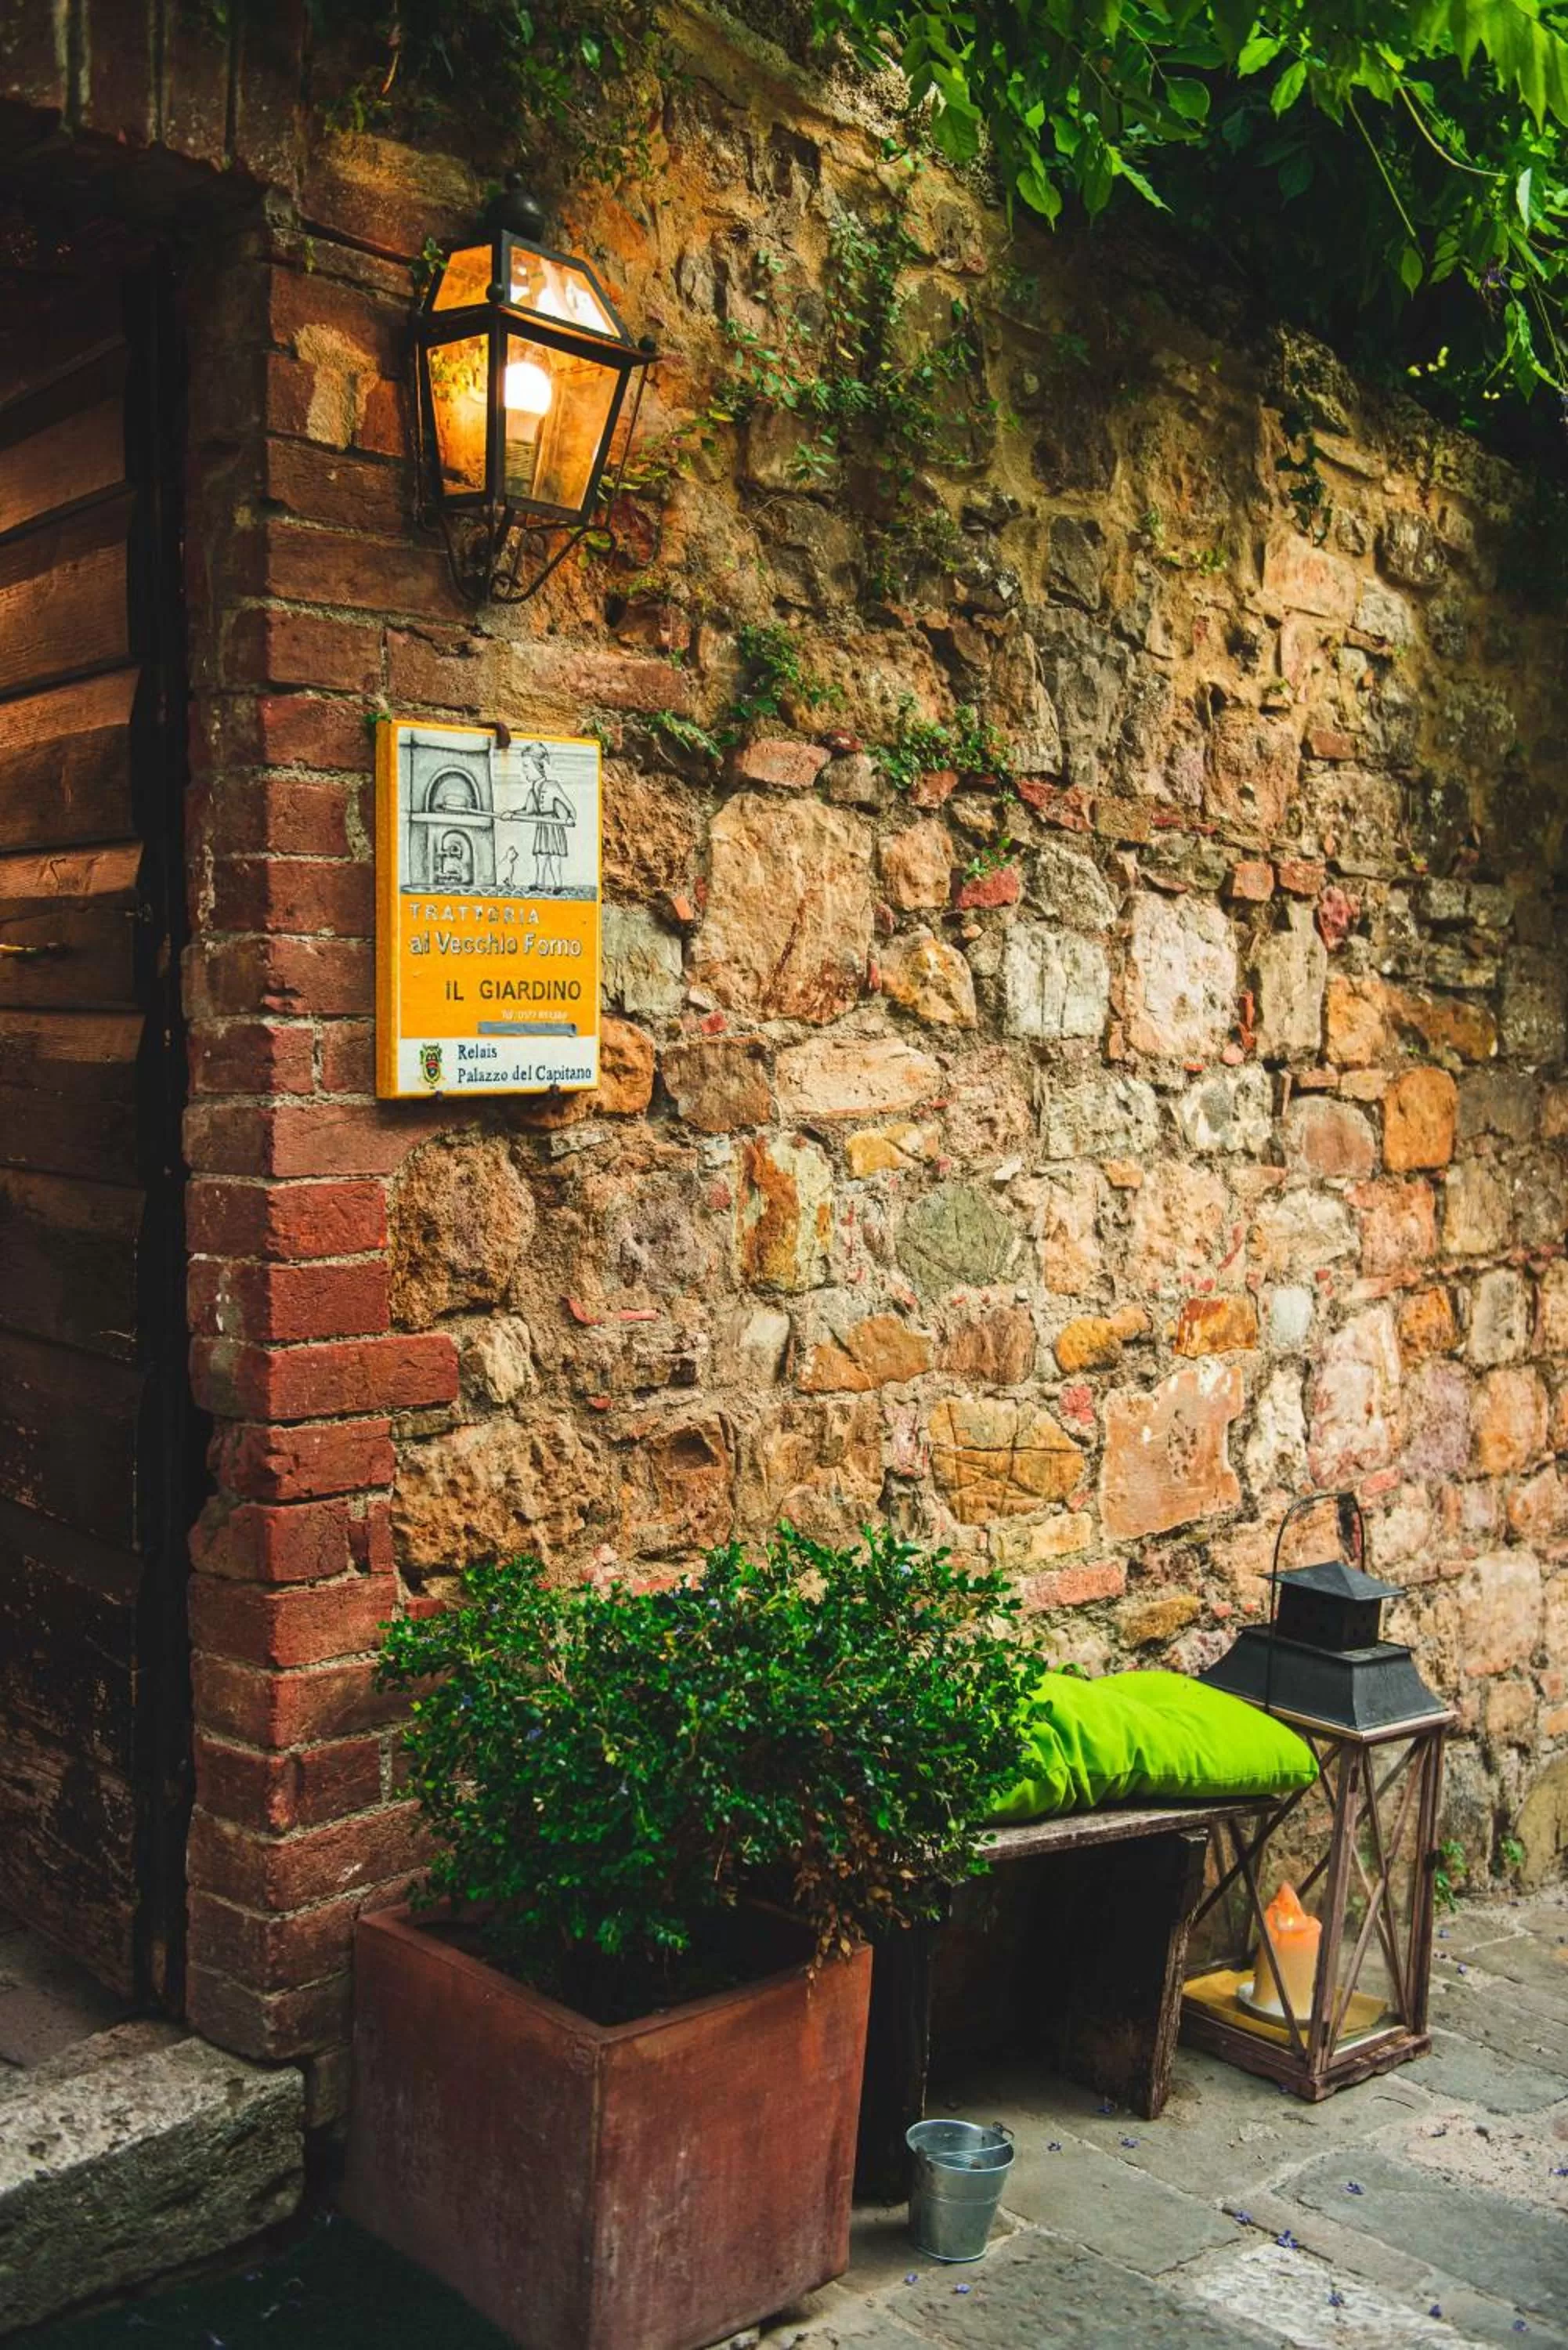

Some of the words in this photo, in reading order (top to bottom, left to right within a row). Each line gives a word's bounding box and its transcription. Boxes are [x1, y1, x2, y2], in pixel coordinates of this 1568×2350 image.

[410, 902, 540, 924] TRATTORIA
[435, 931, 518, 955] Vecchio
[522, 932, 581, 956] Forno
[479, 980, 581, 1001] GIARDINO
[457, 1043, 497, 1060] Relais
[457, 1068, 508, 1083] Palazzo
[513, 1065, 532, 1081] del
[535, 1065, 592, 1083] Capitano
